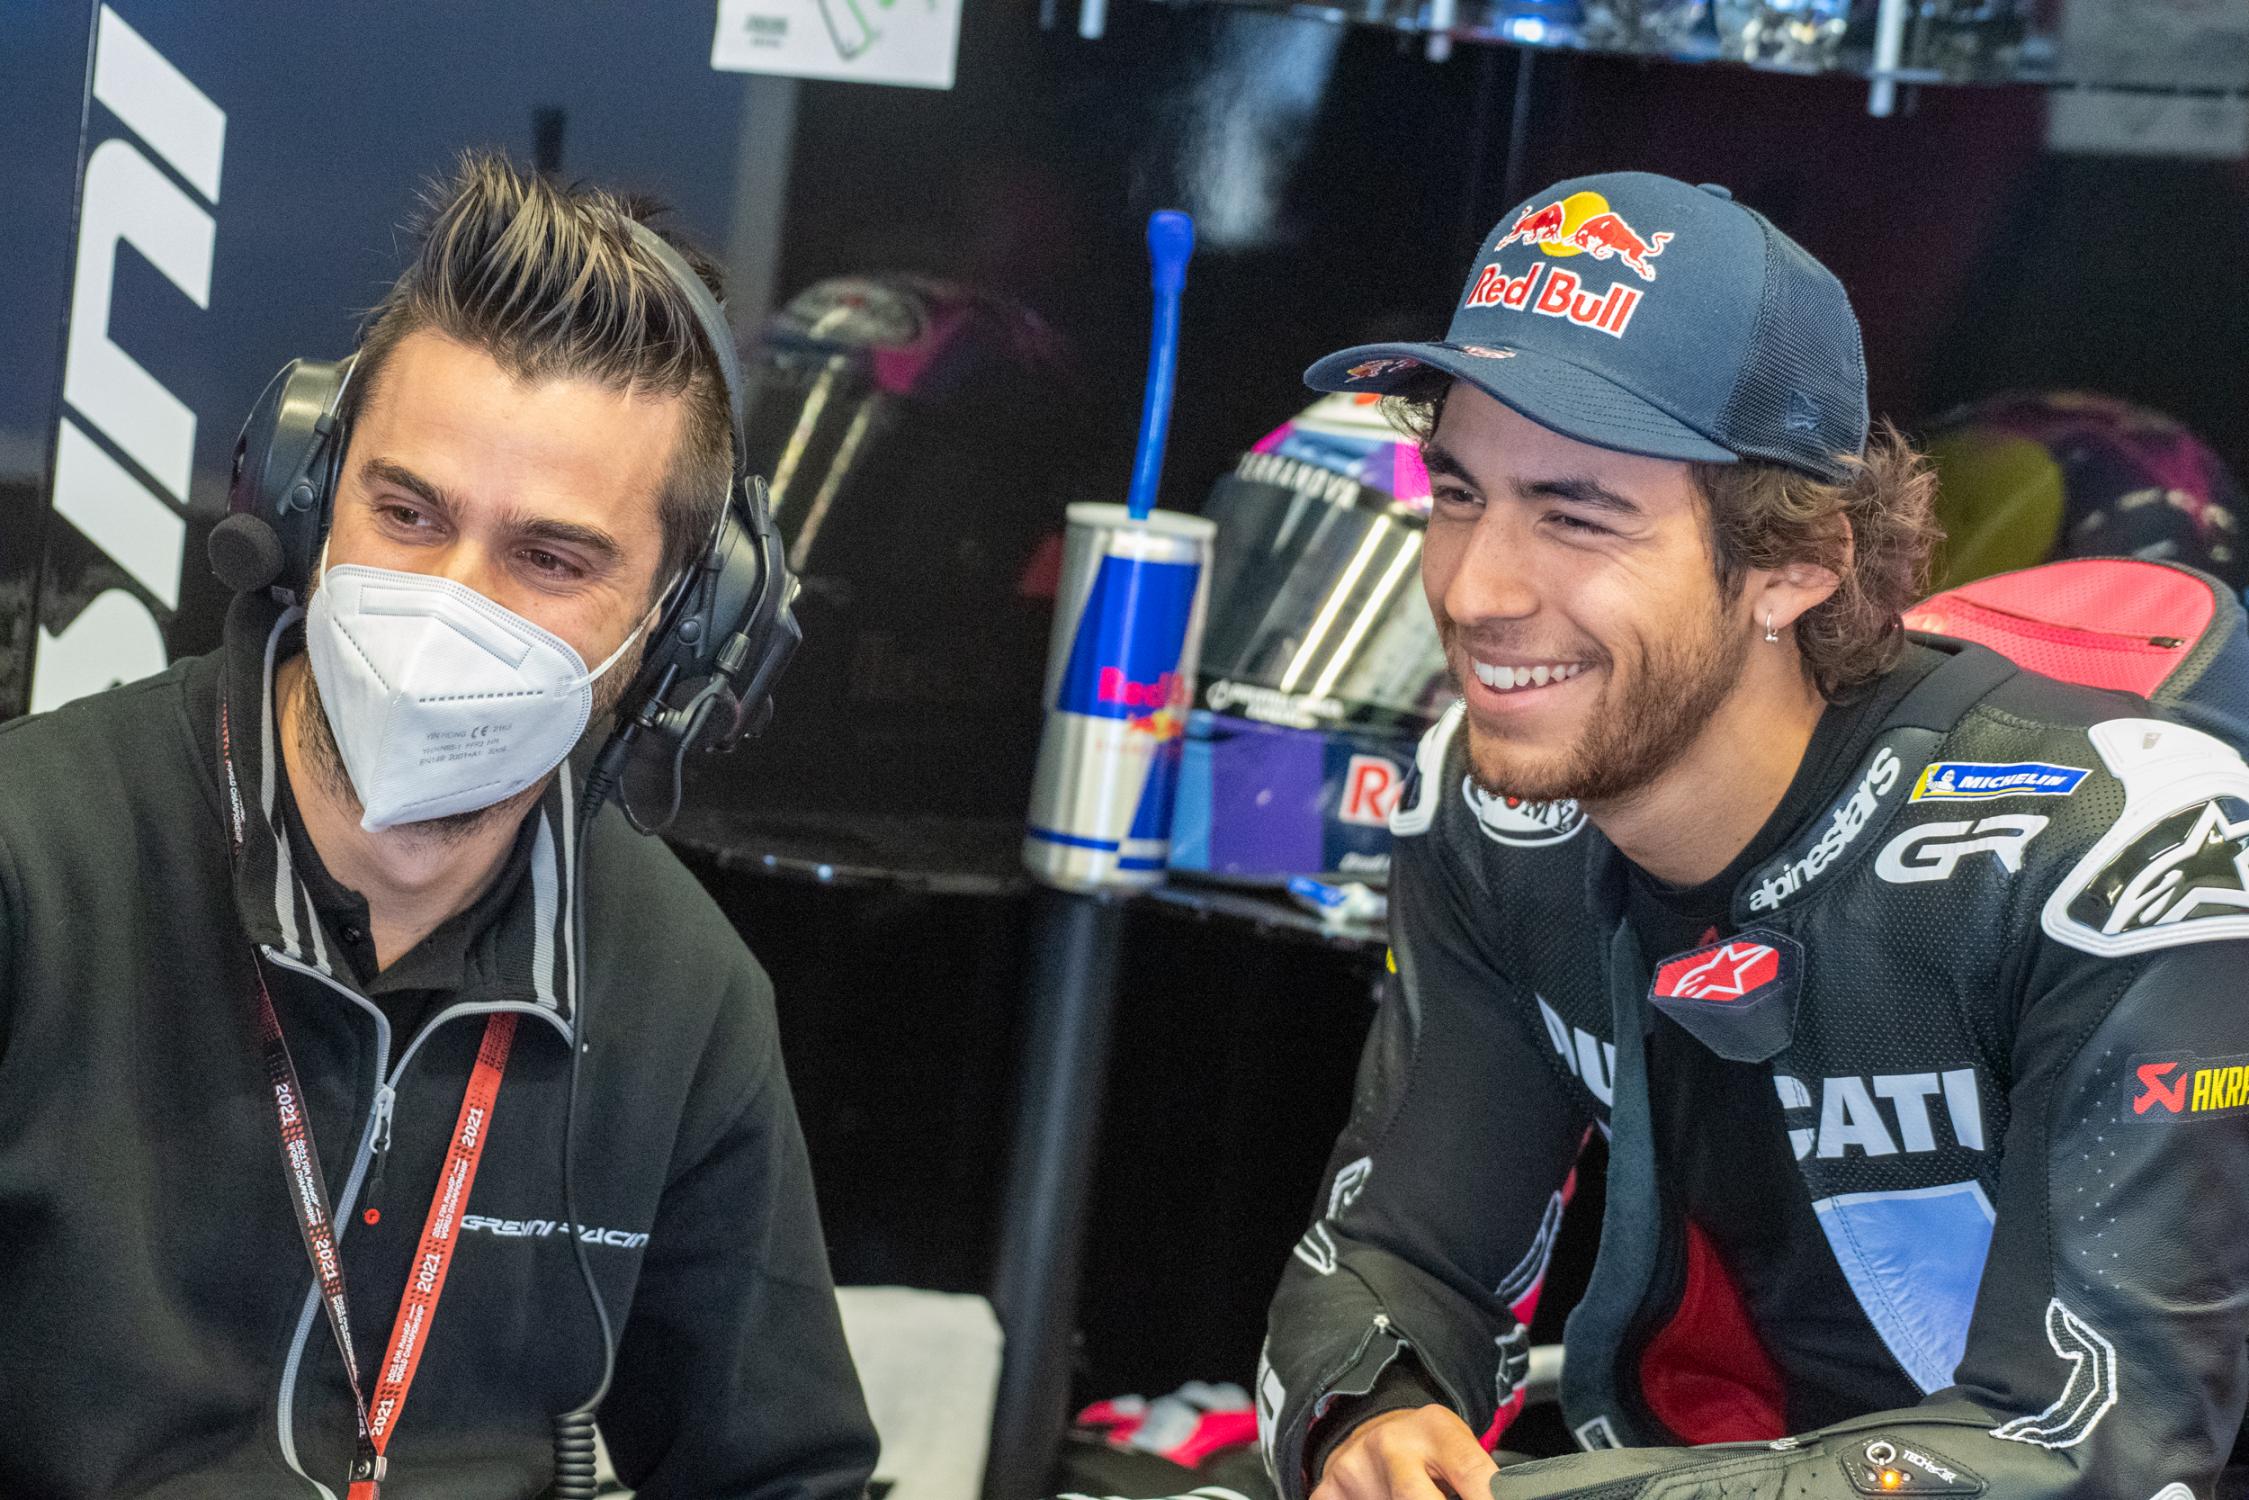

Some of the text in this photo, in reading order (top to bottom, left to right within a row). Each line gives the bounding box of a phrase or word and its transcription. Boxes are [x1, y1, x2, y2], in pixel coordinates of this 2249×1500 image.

[1465, 262, 1644, 339] Red Bull
[1958, 773, 2069, 790] MICHELIN
[1749, 747, 1901, 911] alpinestars
[1875, 813, 2050, 884] GR
[275, 1083, 297, 1126] 2021
[461, 1107, 484, 1147] 2021
[287, 1142, 319, 1227] WORLD CHAMPIONSHIP
[438, 1160, 471, 1240] WORLD CHAMPIONSHIP
[317, 1239, 339, 1281] 2021
[417, 1252, 441, 1294] 2021
[394, 1304, 426, 1384] WORLD CHAMPIONSHIP
[371, 1398, 395, 1437] 2021
